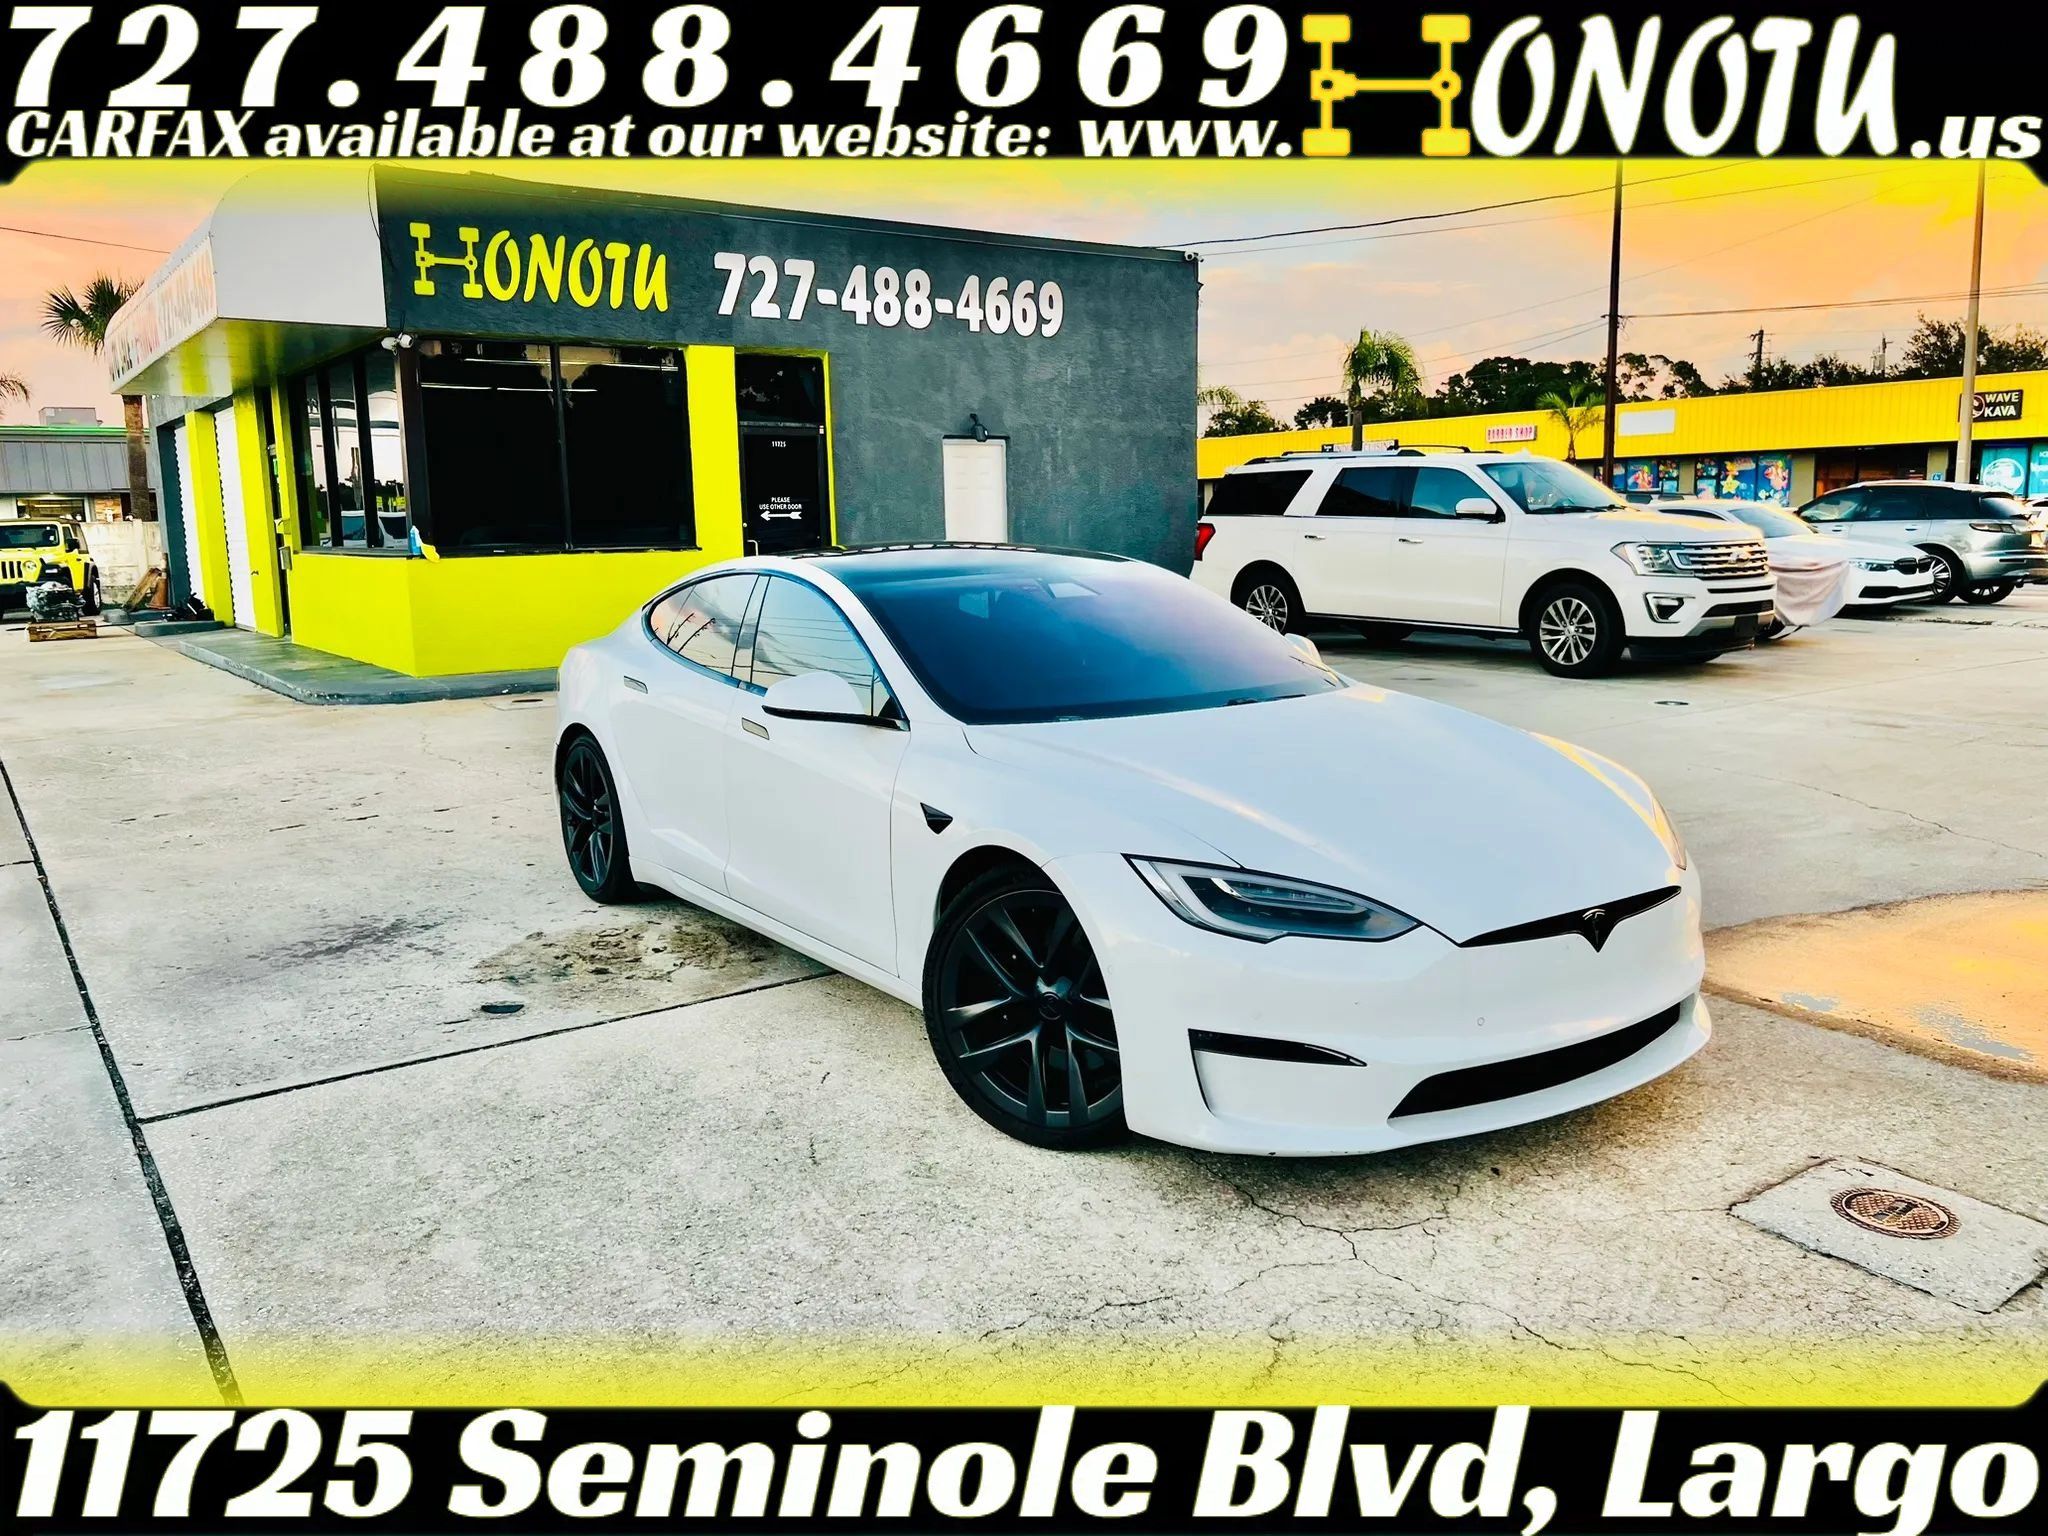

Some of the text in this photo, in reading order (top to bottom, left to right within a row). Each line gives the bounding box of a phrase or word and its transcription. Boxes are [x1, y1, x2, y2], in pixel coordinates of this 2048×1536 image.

[409, 221, 1064, 338] HONOTU 727-488-4669
[1984, 392, 2019, 404] WAVE
[1984, 405, 2016, 417] KAVA
[771, 440, 787, 448] 11725
